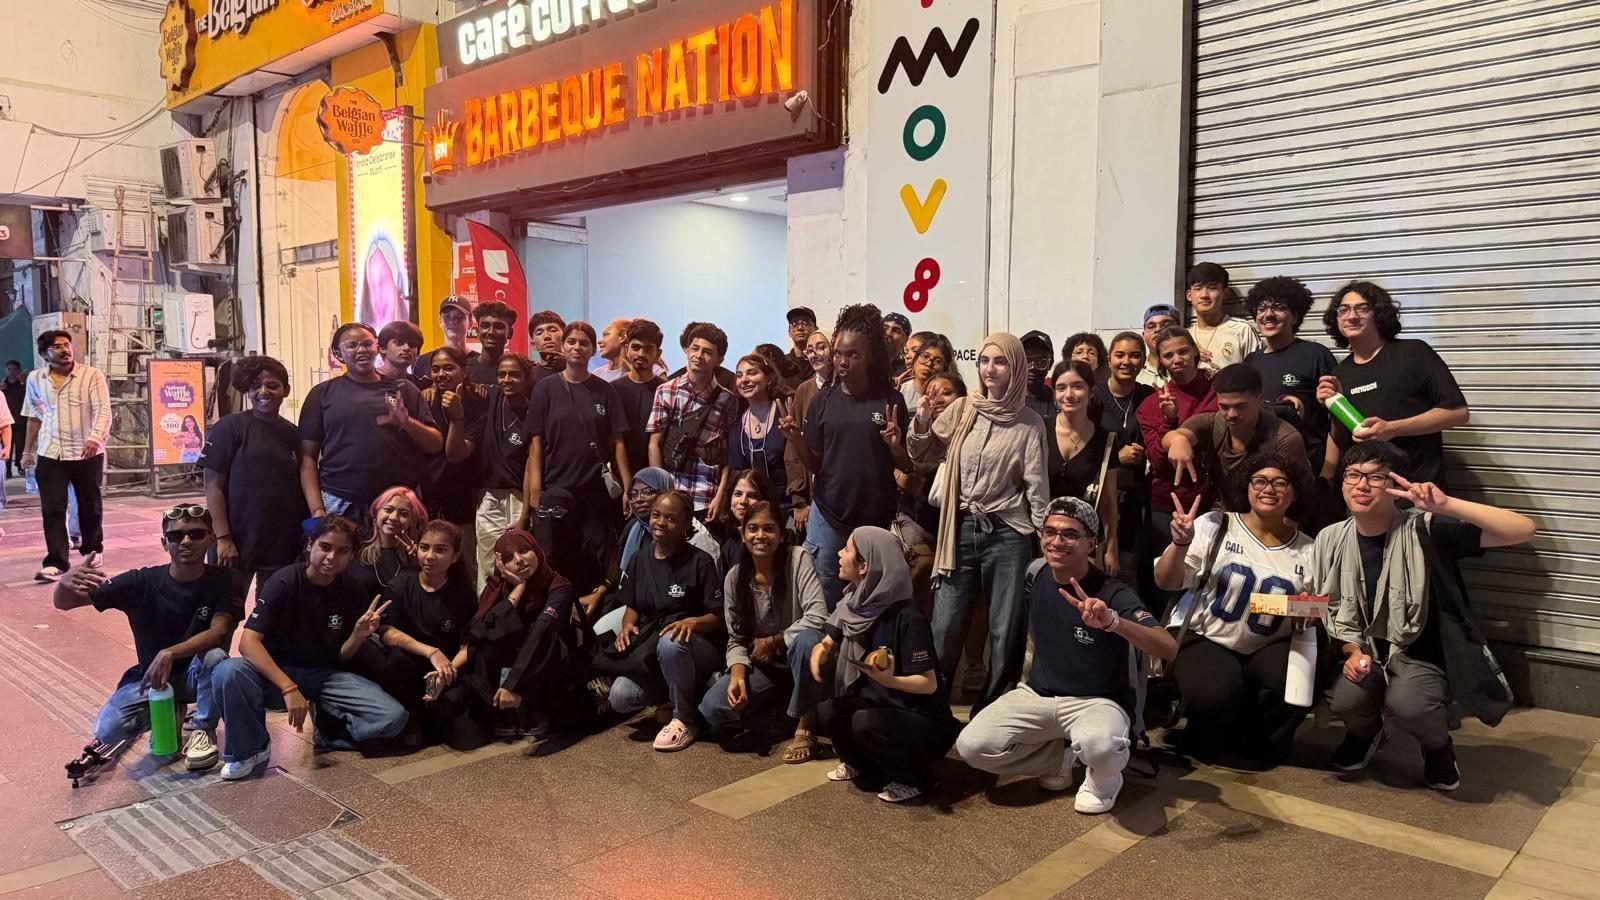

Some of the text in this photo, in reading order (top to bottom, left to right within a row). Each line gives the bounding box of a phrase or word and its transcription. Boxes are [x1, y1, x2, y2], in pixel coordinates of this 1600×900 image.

[464, 0, 798, 168] BARBEQUE NATION
[332, 104, 376, 123] Belgian
[336, 119, 374, 138] Waffle
[434, 141, 448, 161] BN
[164, 389, 191, 401] Waffle
